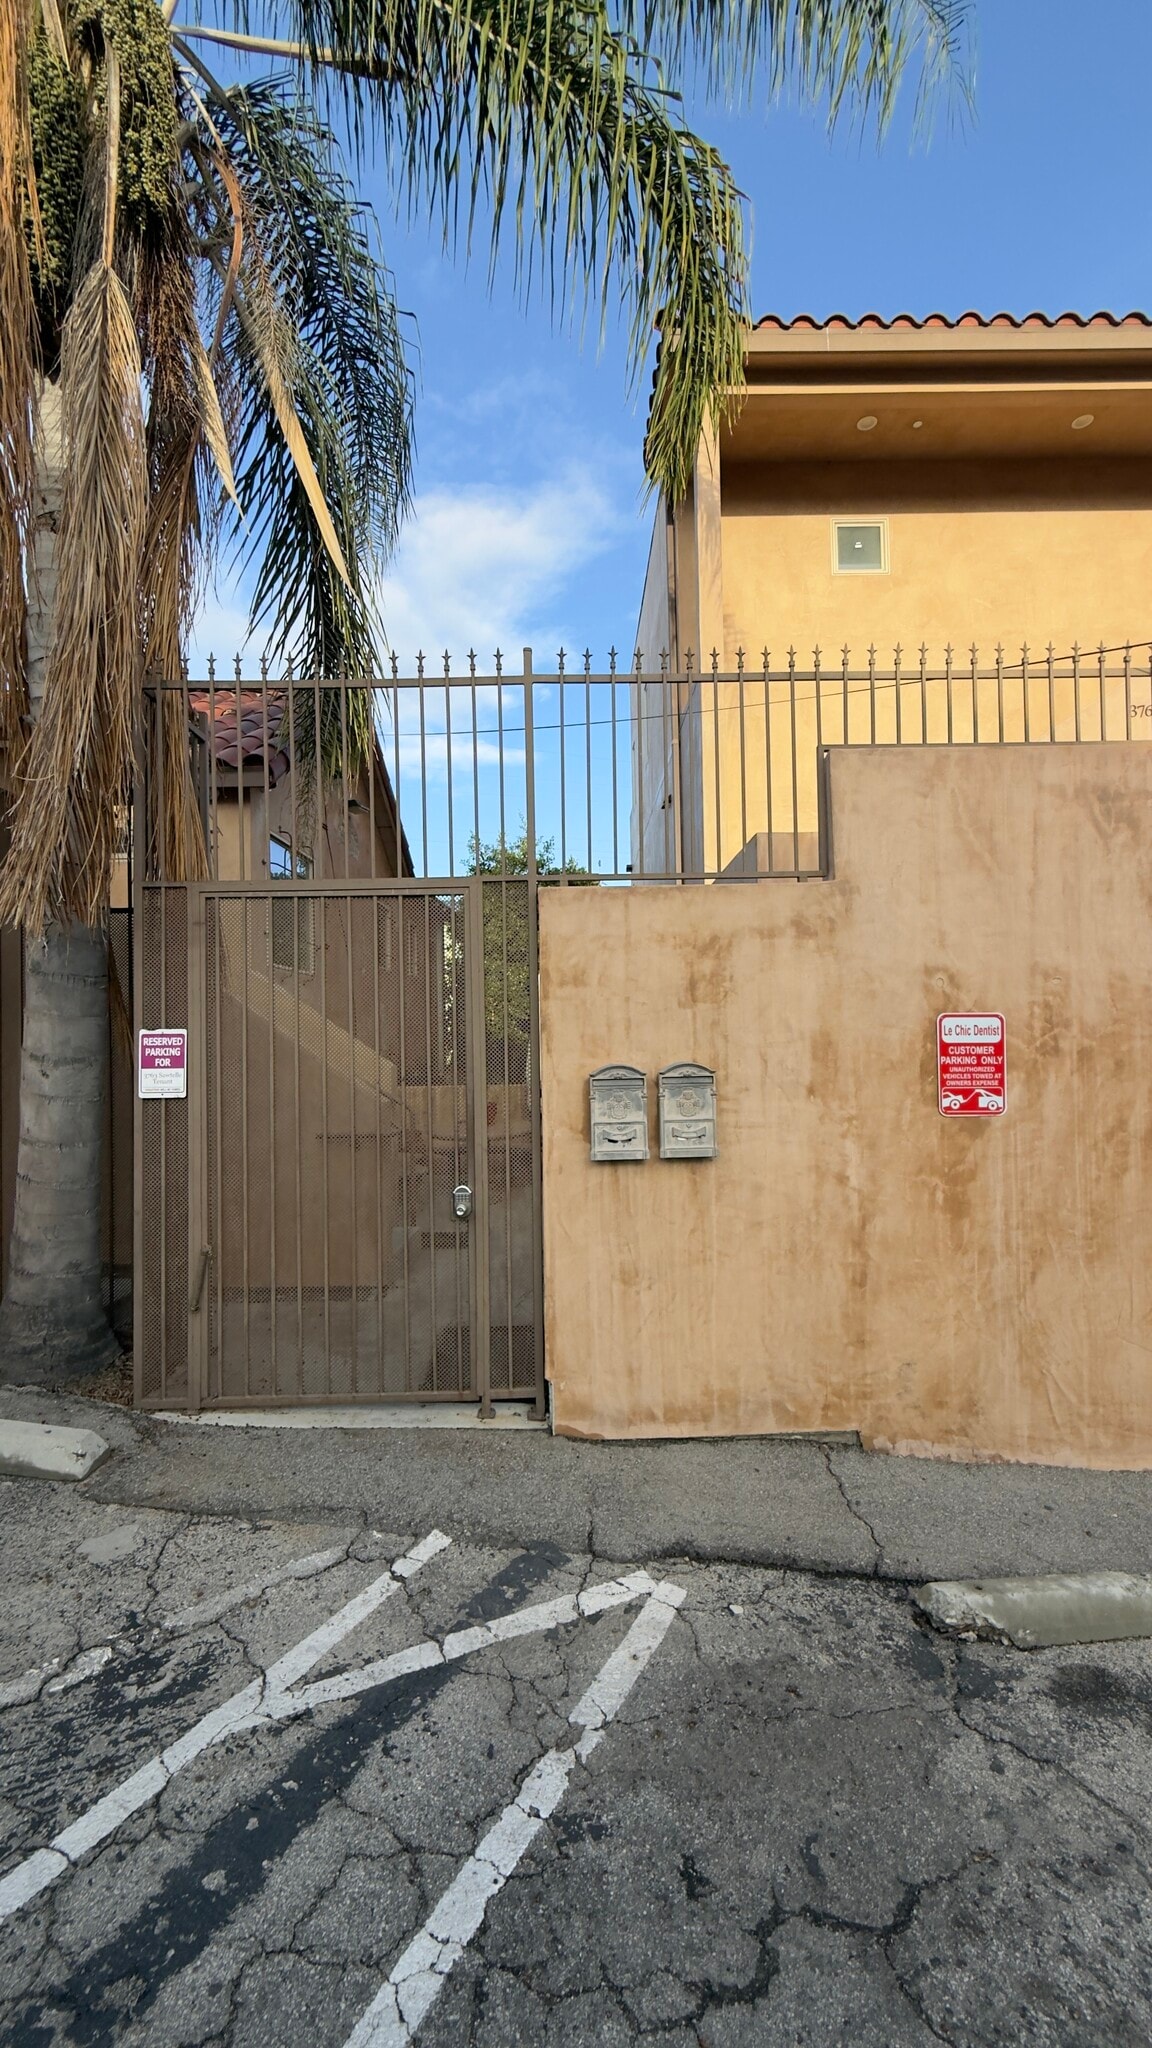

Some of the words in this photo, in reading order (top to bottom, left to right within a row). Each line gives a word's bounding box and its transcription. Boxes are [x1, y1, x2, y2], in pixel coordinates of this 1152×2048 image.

[944, 1025, 953, 1036] Le
[954, 1024, 971, 1036] Chic
[973, 1024, 1000, 1036] Dentist
[143, 1037, 183, 1046] RESERVED
[145, 1048, 181, 1056] PARKING
[948, 1046, 995, 1055] CUSTOMER
[155, 1058, 171, 1067] FOR
[940, 1056, 977, 1065] PARKING
[981, 1056, 1003, 1065] ONLY
